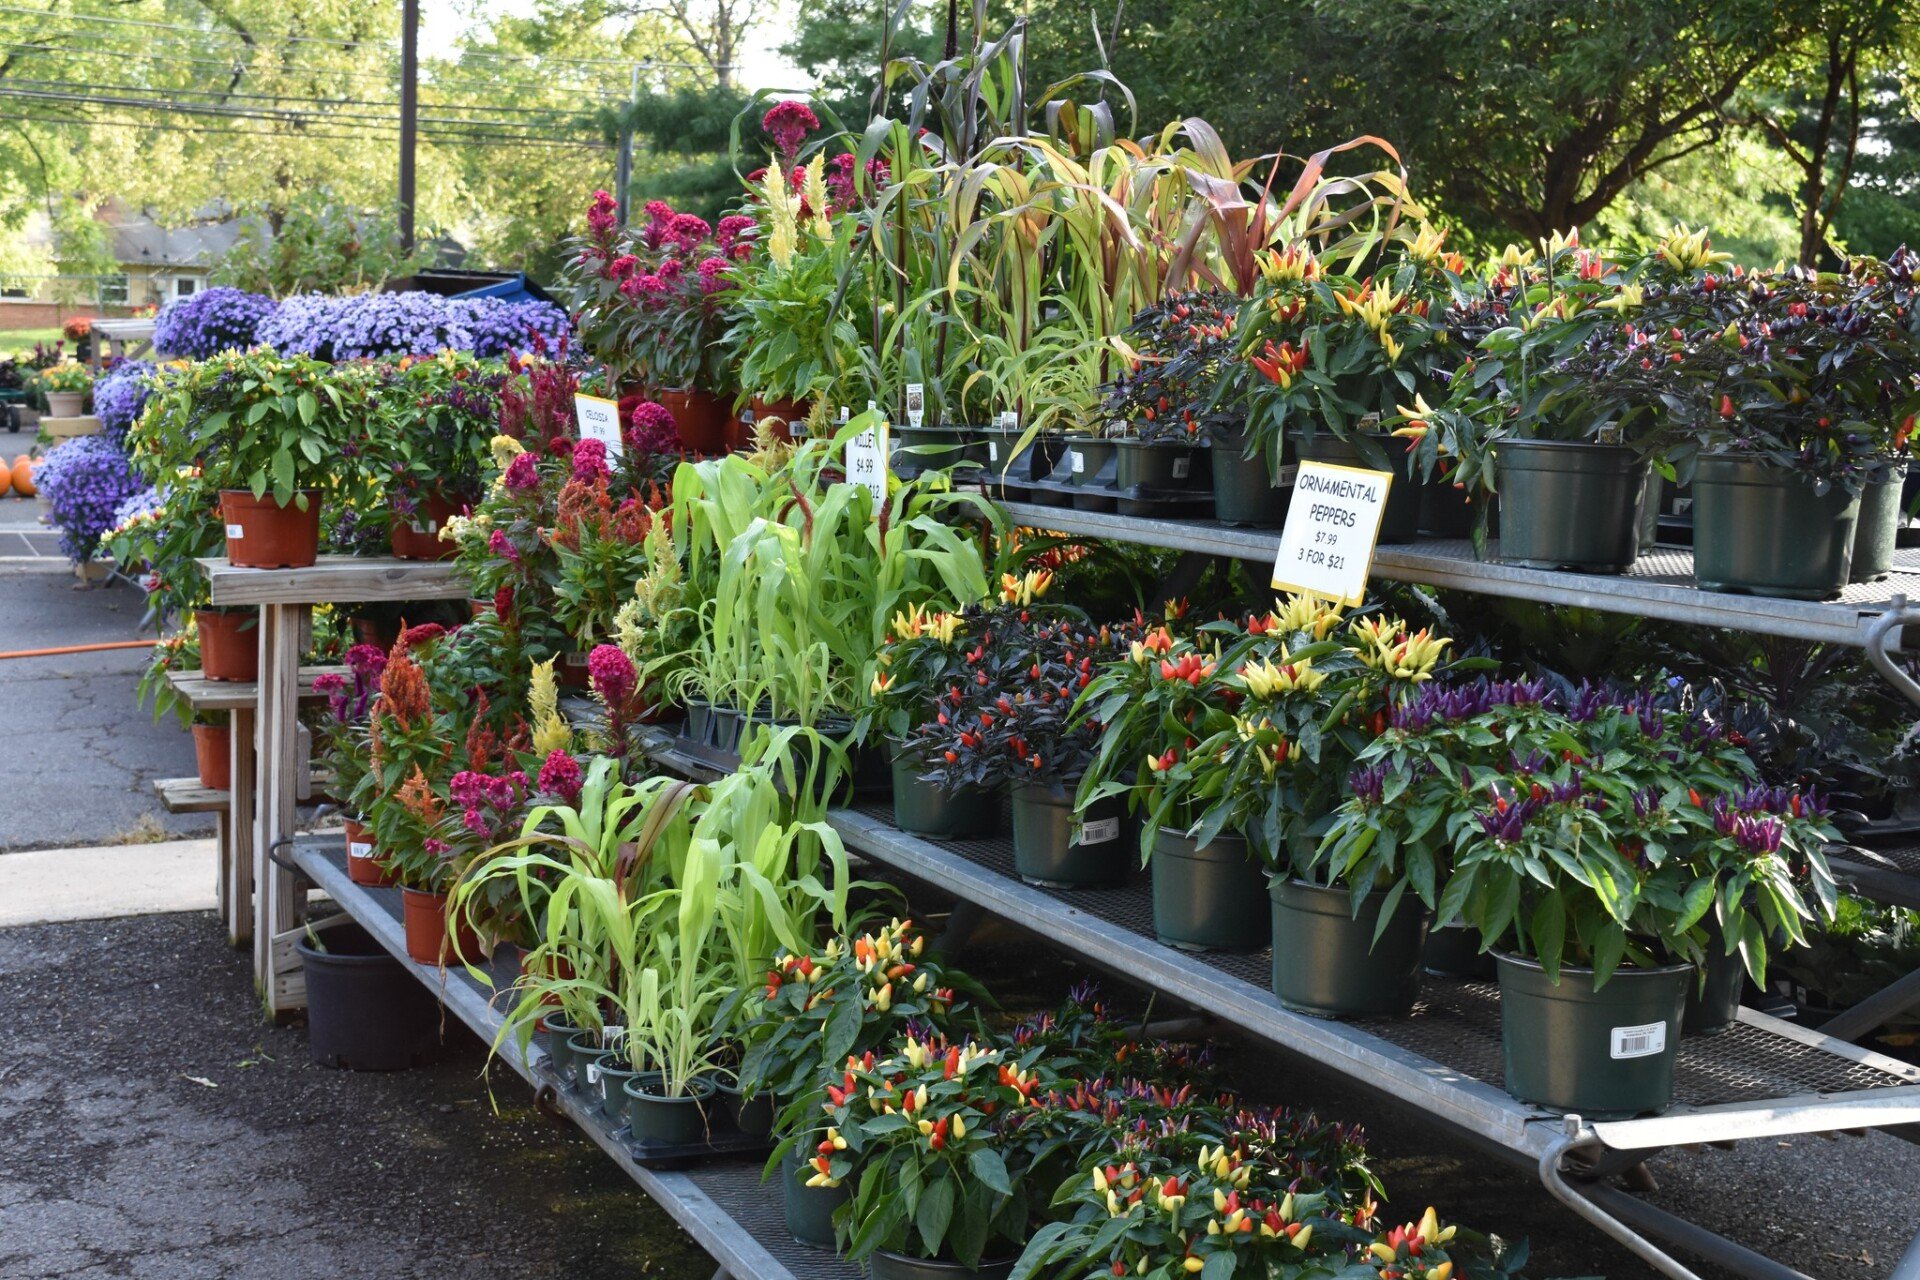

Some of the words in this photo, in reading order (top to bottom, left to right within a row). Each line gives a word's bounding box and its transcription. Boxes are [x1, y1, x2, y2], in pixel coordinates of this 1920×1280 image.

[856, 458, 873, 474] $4.99
[1299, 474, 1377, 503] ORNAMENTAL
[1309, 504, 1356, 527] PEPPERS
[1315, 531, 1338, 546] $7.99
[1297, 548, 1304, 561] 3
[1306, 549, 1325, 565] FOR
[1327, 553, 1345, 570] $21
